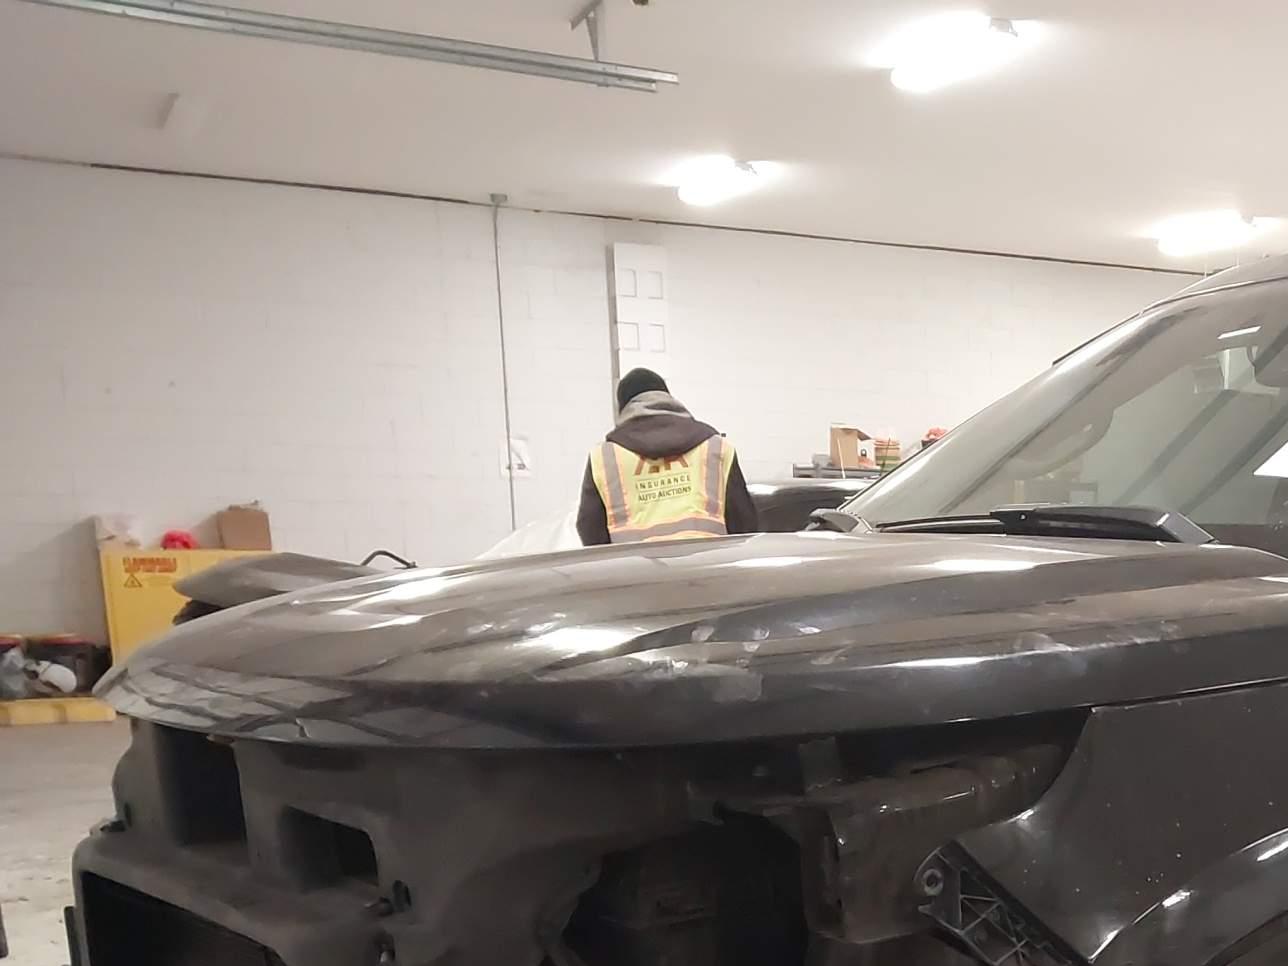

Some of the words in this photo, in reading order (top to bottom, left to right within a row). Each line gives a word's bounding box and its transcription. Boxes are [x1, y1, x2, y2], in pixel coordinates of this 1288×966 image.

[635, 475, 691, 490] INSURANCE
[638, 492, 657, 501] AUTO
[658, 485, 692, 498] AUCTIONS
